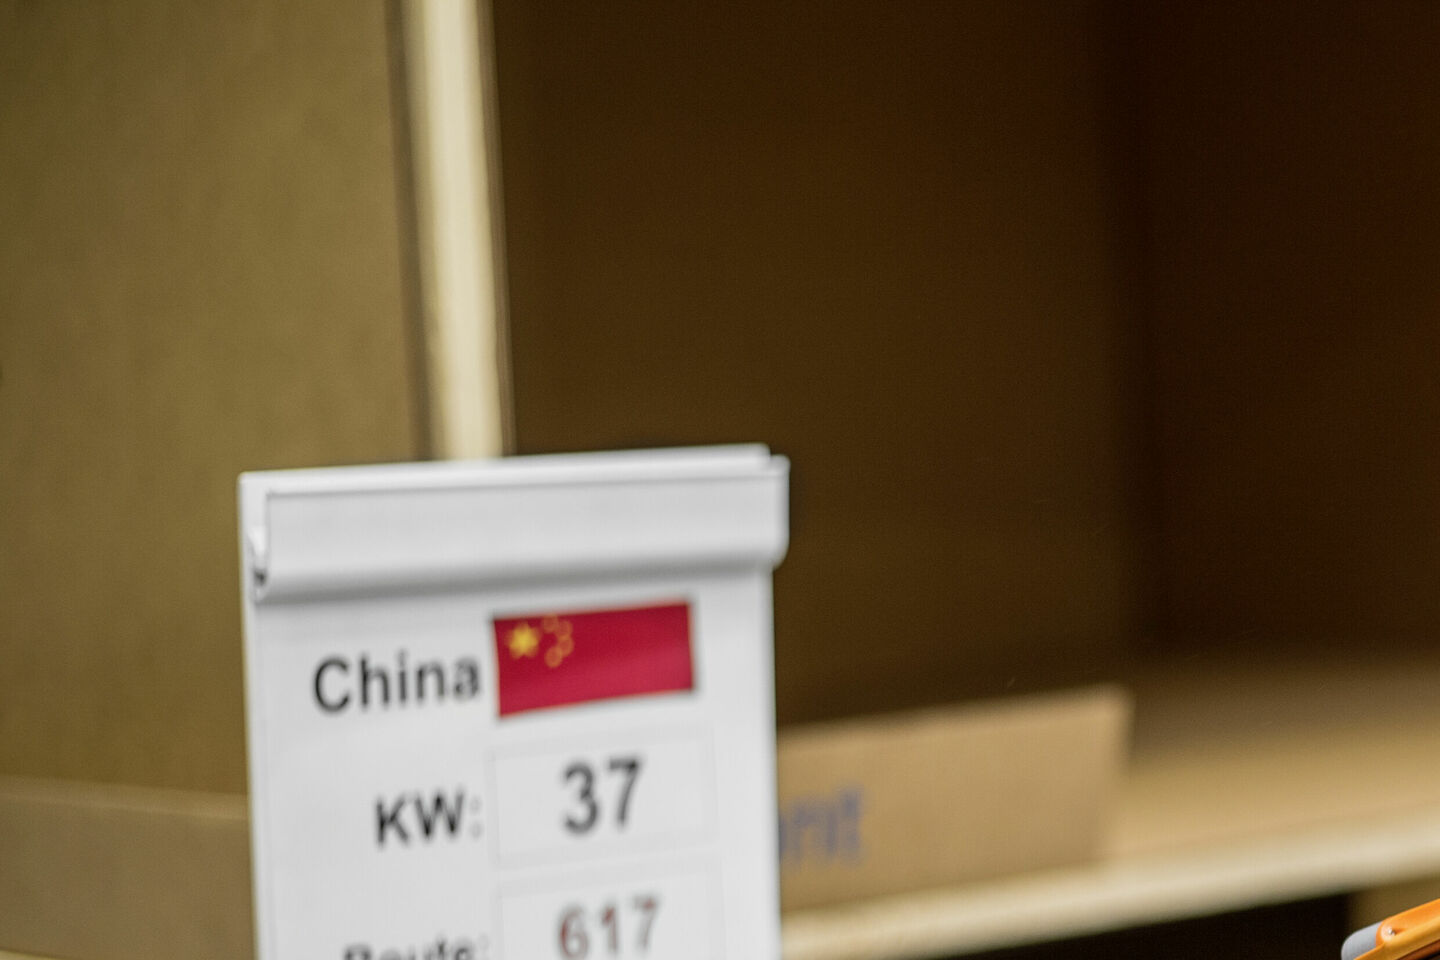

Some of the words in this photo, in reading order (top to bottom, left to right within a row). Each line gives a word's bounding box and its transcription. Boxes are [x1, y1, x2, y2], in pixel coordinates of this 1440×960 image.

[312, 648, 482, 714] China
[372, 789, 484, 850] KW:
[560, 756, 644, 836] 37
